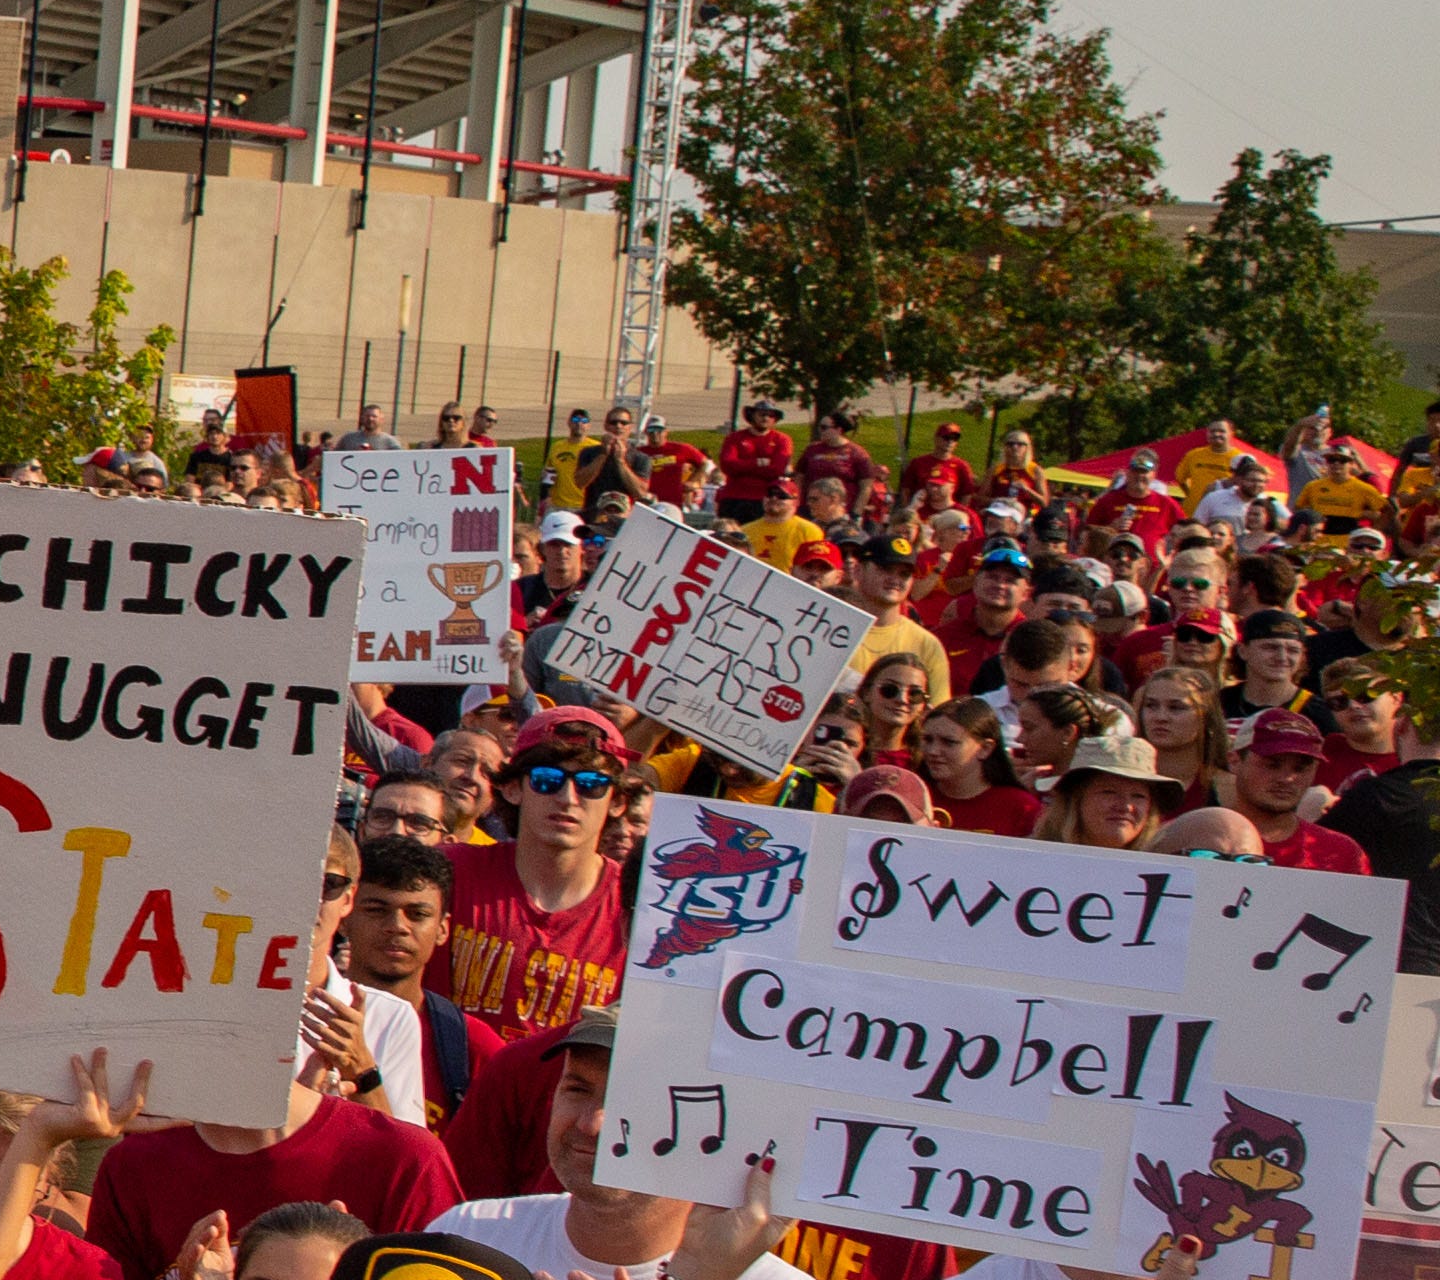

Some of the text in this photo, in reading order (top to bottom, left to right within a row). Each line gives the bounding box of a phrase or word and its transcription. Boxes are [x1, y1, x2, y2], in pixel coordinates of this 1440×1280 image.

[333, 454, 401, 493] See
[413, 460, 448, 495] Ya
[597, 551, 813, 685] HUSKERS
[654, 516, 852, 649] TELL the
[564, 627, 679, 716] TRYING
[581, 601, 804, 719] to PLEASE STOP
[838, 837, 1193, 951] Sweet
[720, 967, 1215, 1110] Campbell
[815, 1116, 1093, 1239] Time
